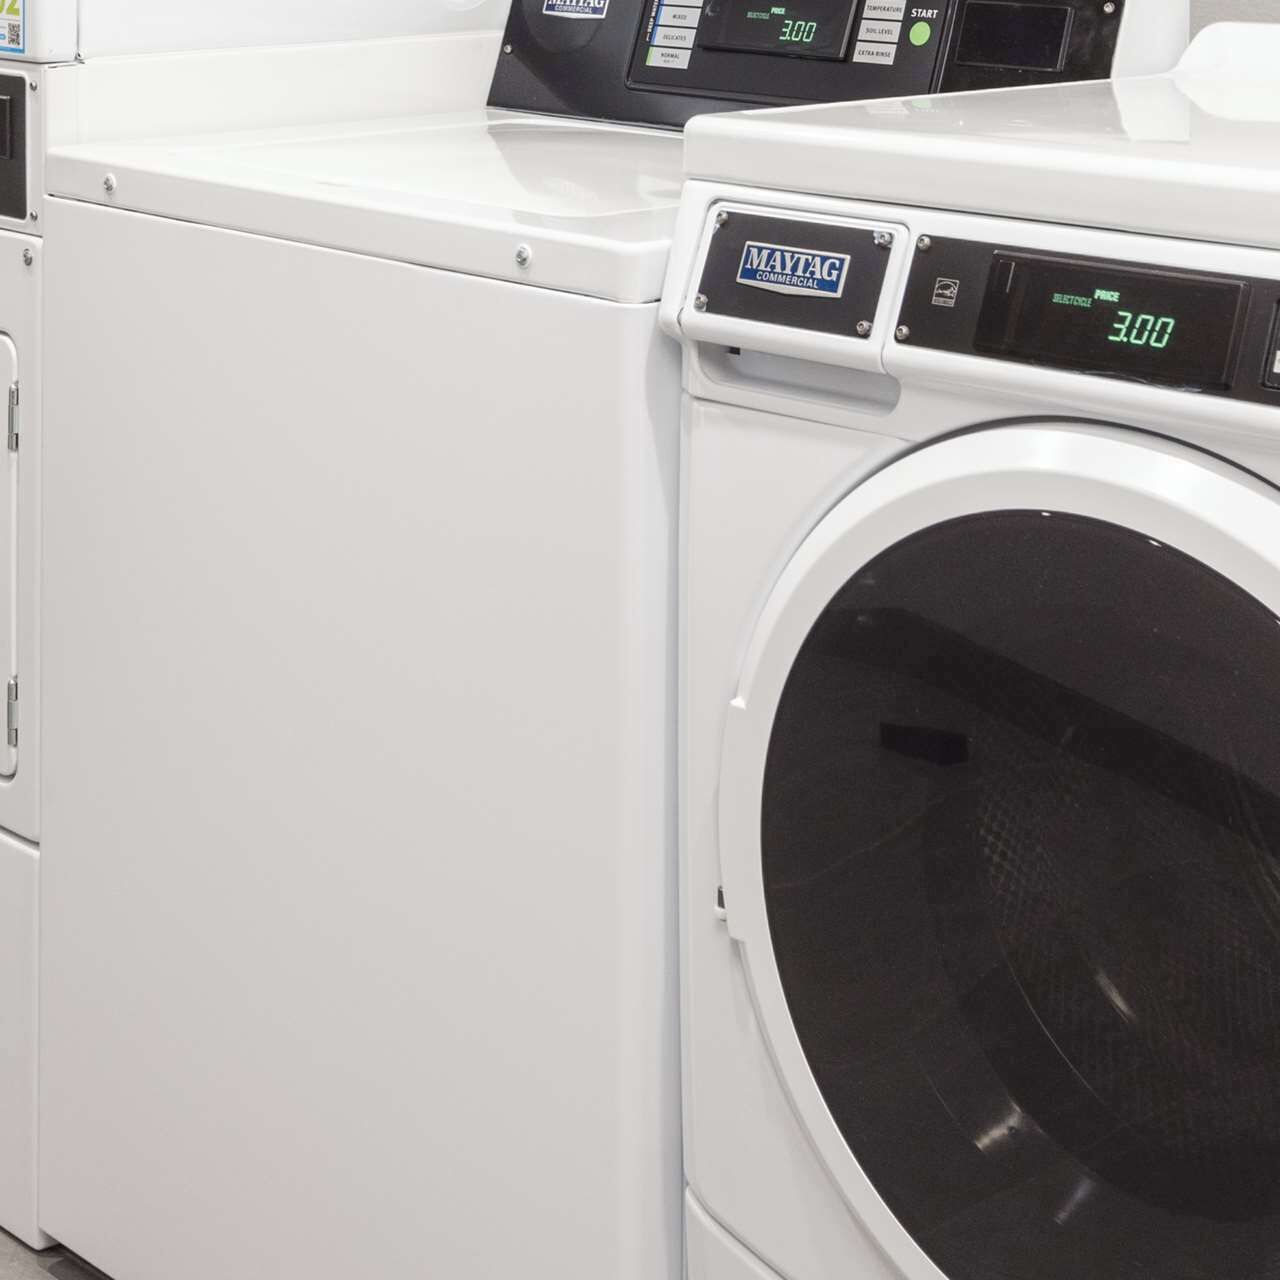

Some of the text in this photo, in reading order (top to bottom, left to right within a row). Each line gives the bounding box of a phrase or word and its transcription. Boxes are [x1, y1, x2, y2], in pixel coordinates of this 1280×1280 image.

[910, 8, 938, 18] START
[779, 20, 817, 42] 3.00
[744, 247, 840, 281] MAYTAG
[756, 271, 818, 288] COMMERCIAL
[1094, 289, 1120, 302] PRICE
[1108, 311, 1175, 348] 3.00
